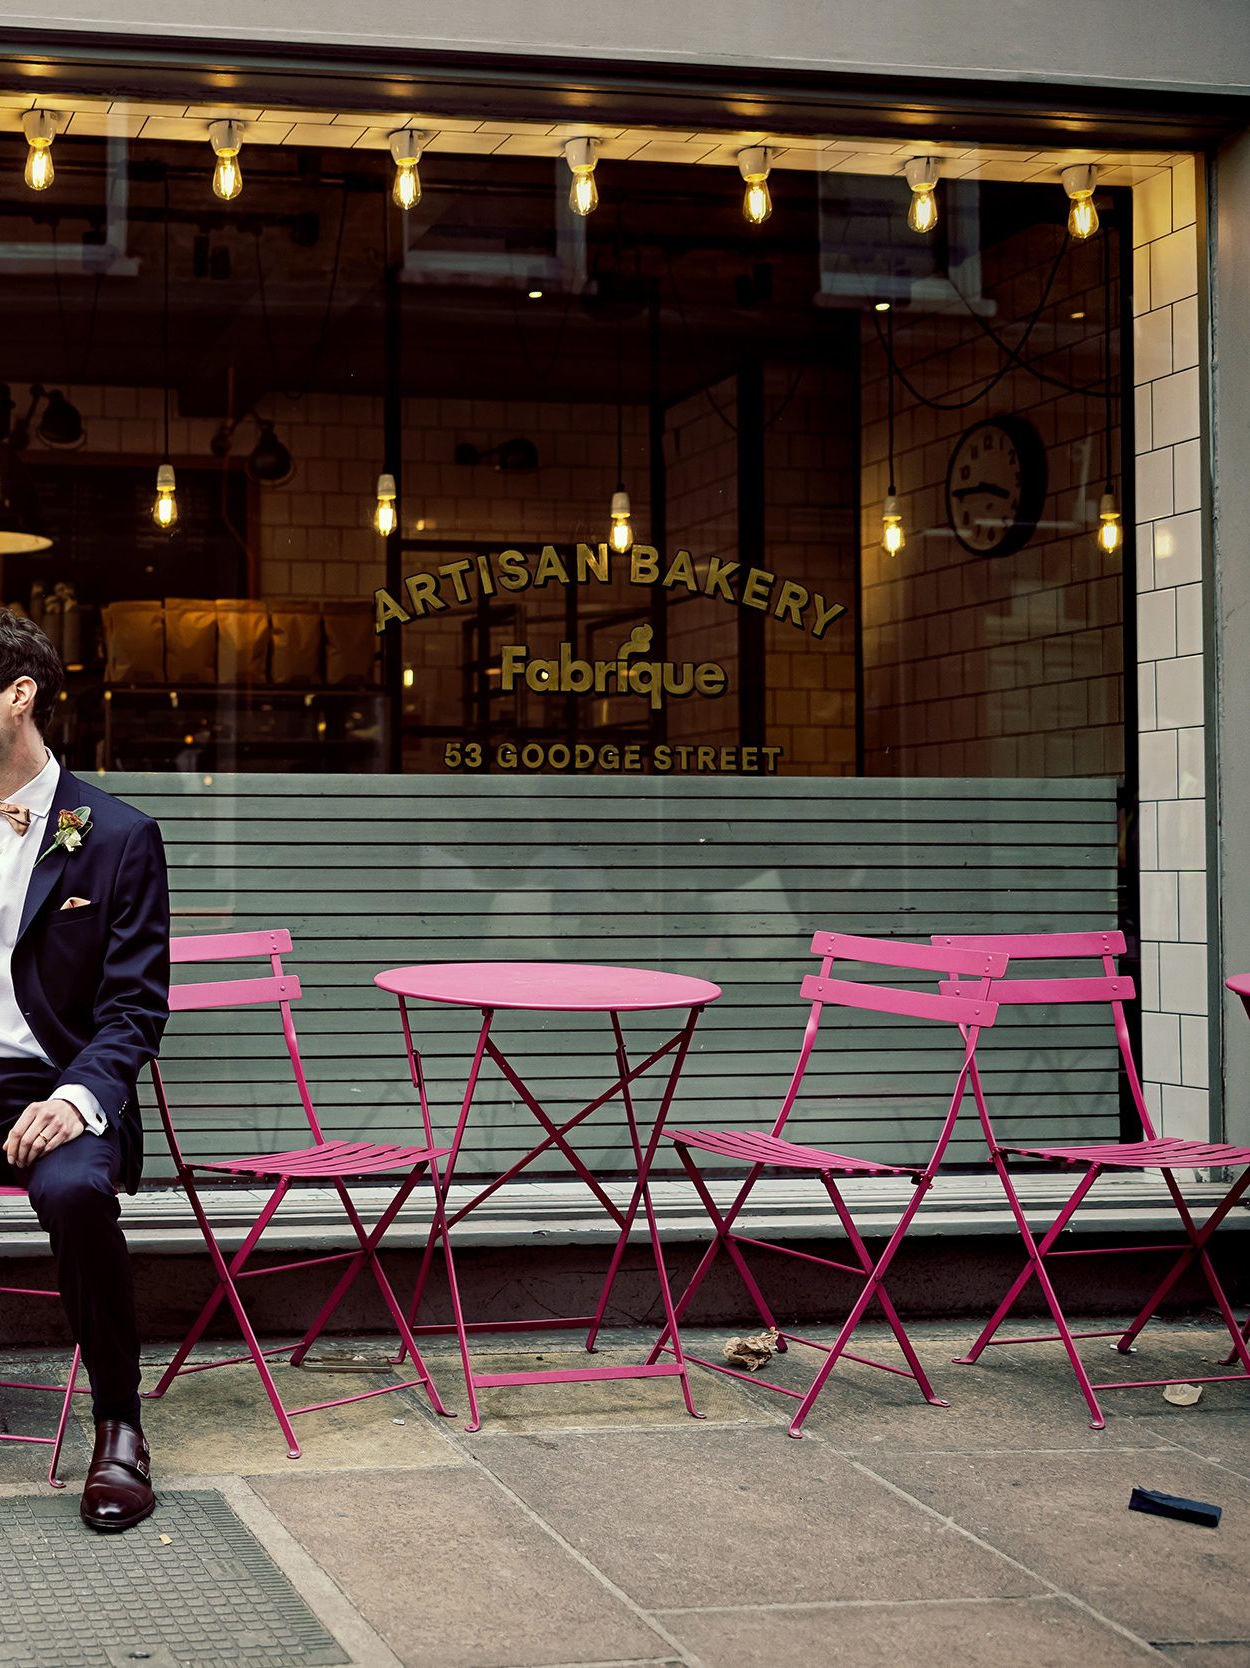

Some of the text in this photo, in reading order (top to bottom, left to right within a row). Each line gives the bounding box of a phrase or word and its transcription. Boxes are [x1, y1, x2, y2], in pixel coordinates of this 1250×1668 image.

[375, 543, 847, 639] ARTISAN BAKERY
[501, 625, 728, 709] Fabrique
[444, 743, 783, 772] 53 GOODGE STREET
